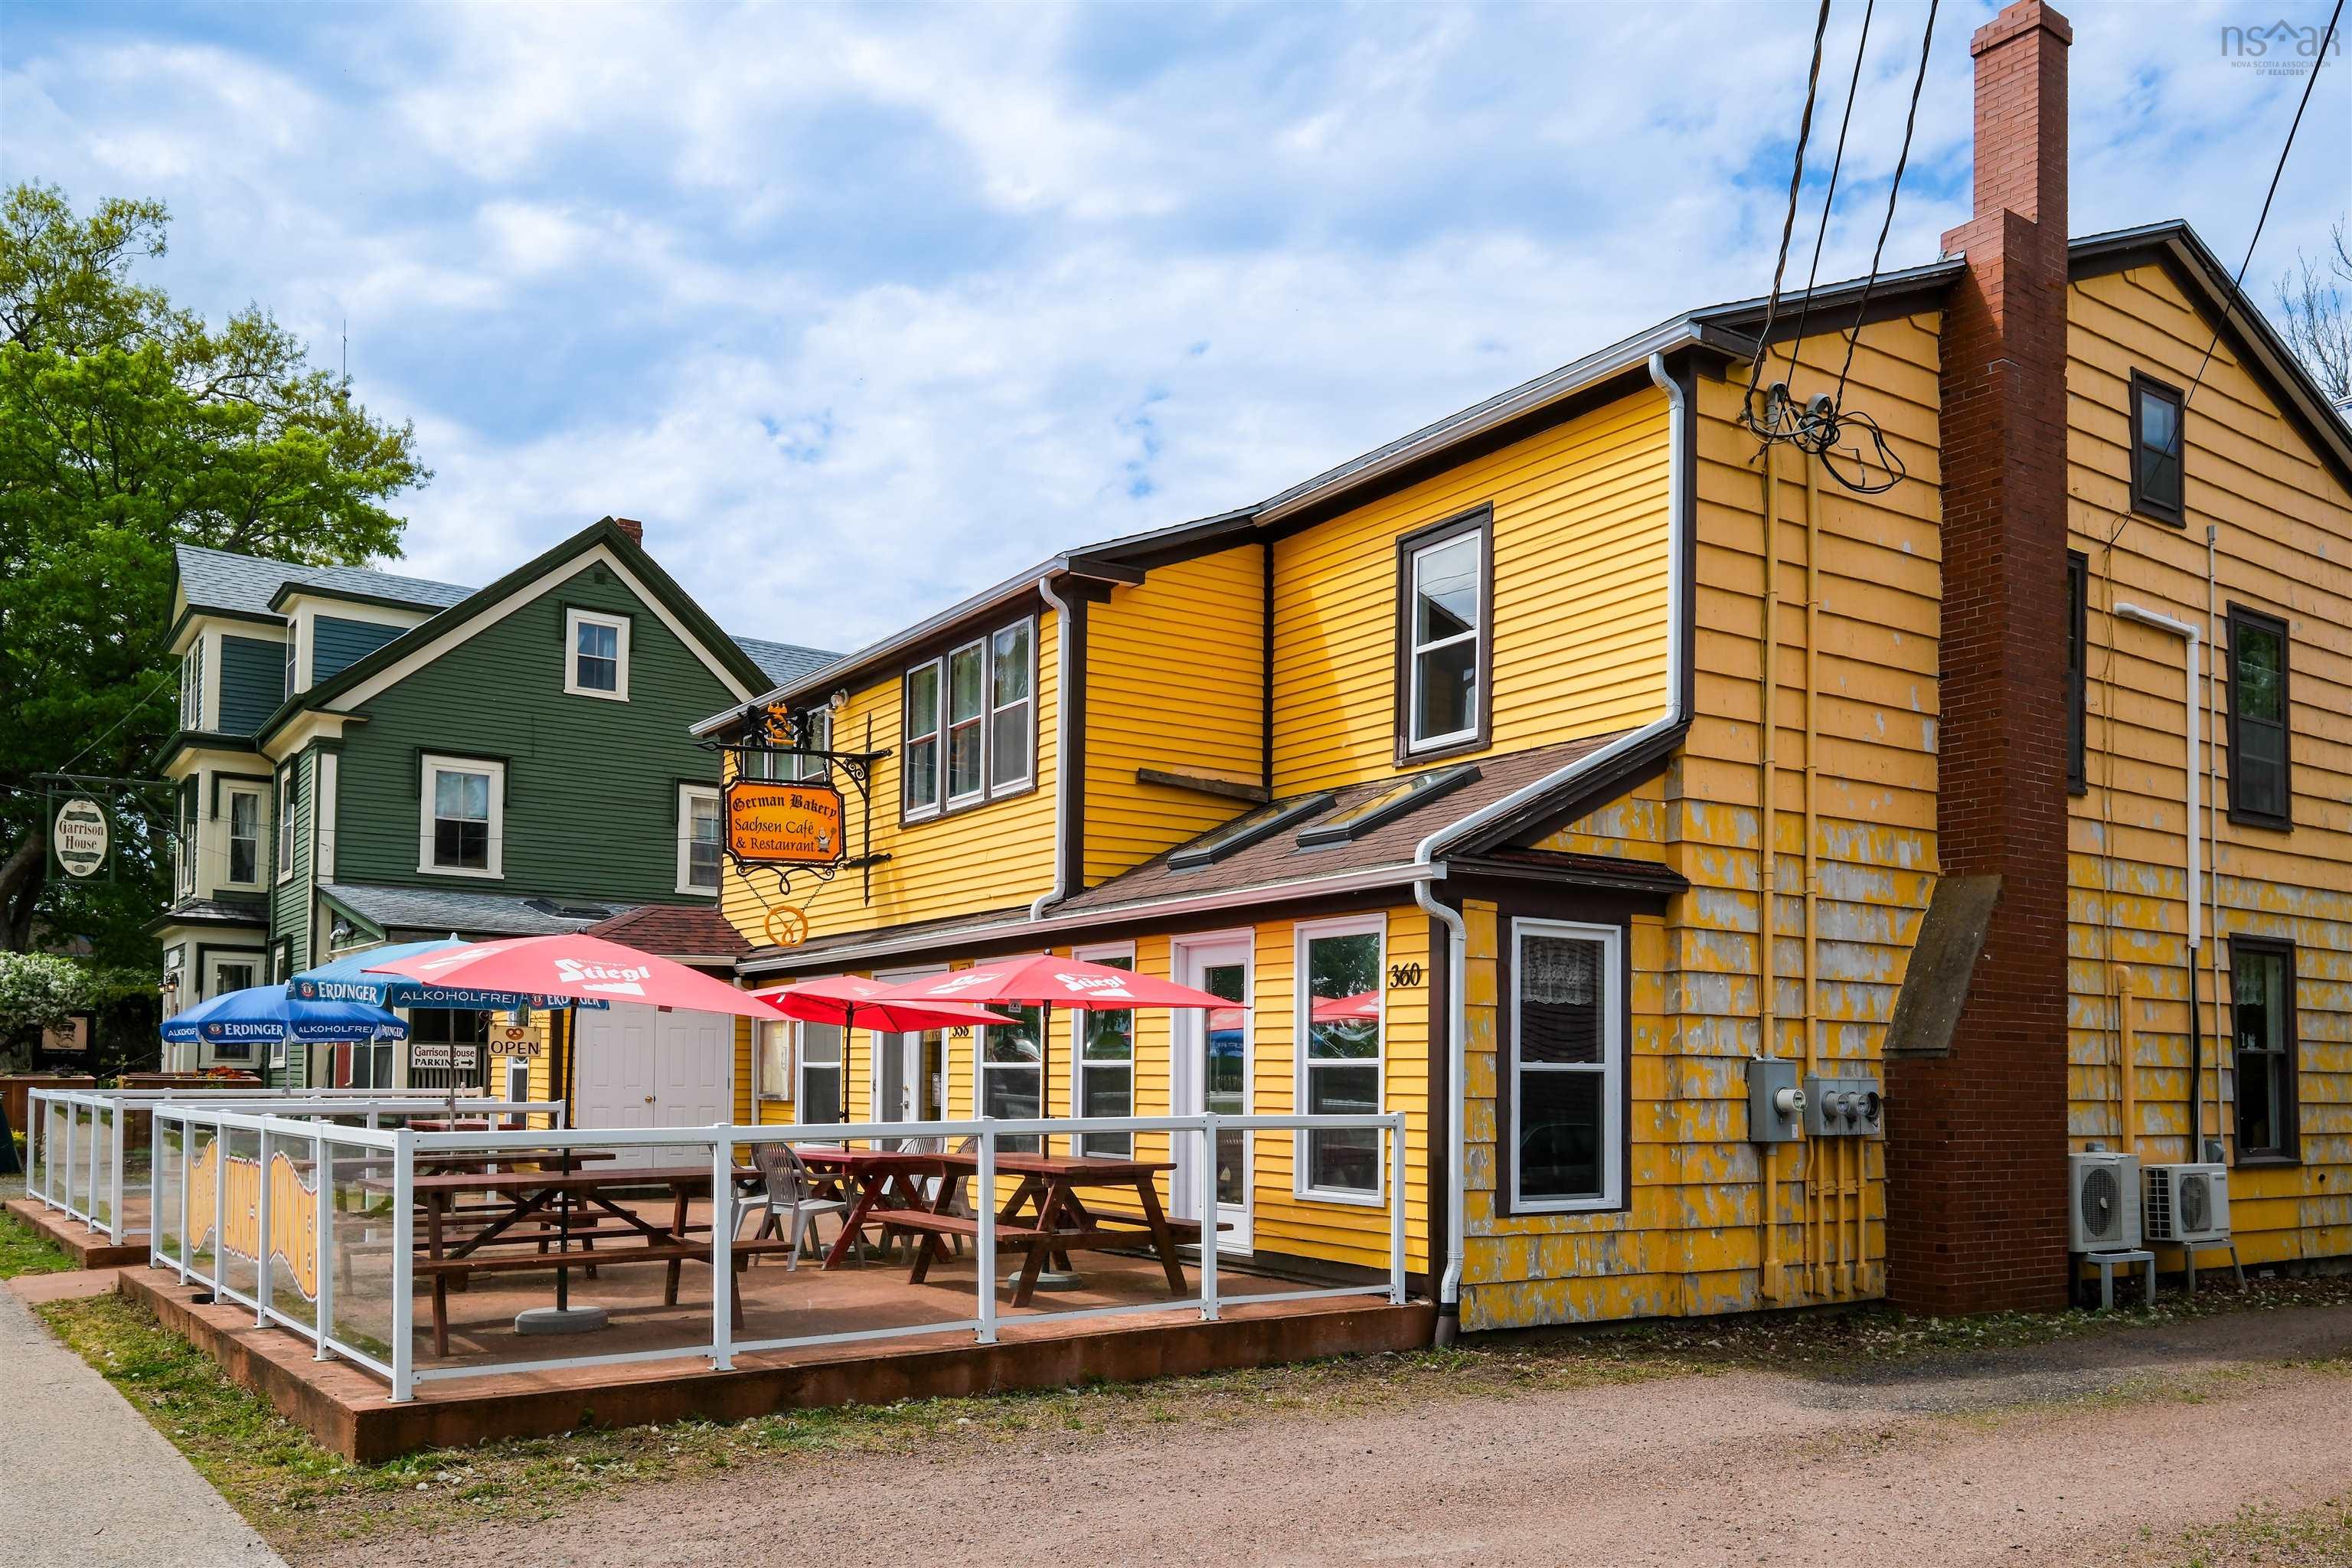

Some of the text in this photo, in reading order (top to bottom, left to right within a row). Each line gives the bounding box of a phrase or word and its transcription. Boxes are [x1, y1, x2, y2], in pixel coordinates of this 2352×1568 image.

[733, 794, 837, 820] German Bakery
[59, 820, 103, 836] Garrison
[735, 816, 814, 838] Sachsen Café
[66, 835, 97, 850] House
[736, 836, 815, 851] & Restaurant
[554, 958, 651, 982] Stiegl
[1390, 962, 1420, 988] 360
[318, 982, 377, 1004] ERDINGER
[400, 990, 516, 1004] ALKOHOLFREI
[547, 995, 601, 1008] ERDGER
[168, 1027, 197, 1037] ALKOHOLF
[224, 1023, 284, 1037] ERDINGER
[299, 1025, 374, 1034] ALKOHOLFREI
[414, 1046, 449, 1057] Garrison
[490, 1040, 540, 1055] OPEN
[415, 1058, 459, 1067] PARKING
